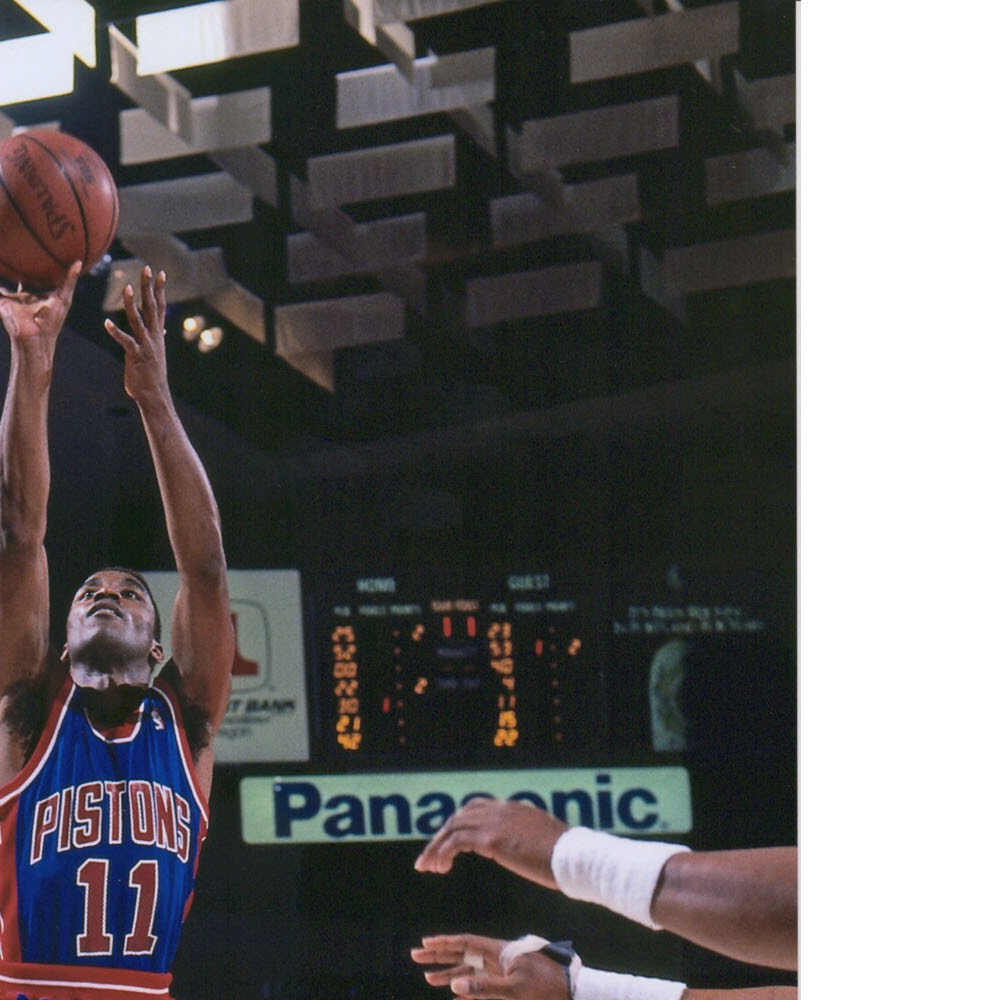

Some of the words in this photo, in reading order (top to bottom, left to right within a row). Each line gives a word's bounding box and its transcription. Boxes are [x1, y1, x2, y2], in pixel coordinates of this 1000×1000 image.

[30, 779, 190, 865] PISTONS
[273, 773, 660, 838] Pananic
[76, 858, 159, 957] 11
